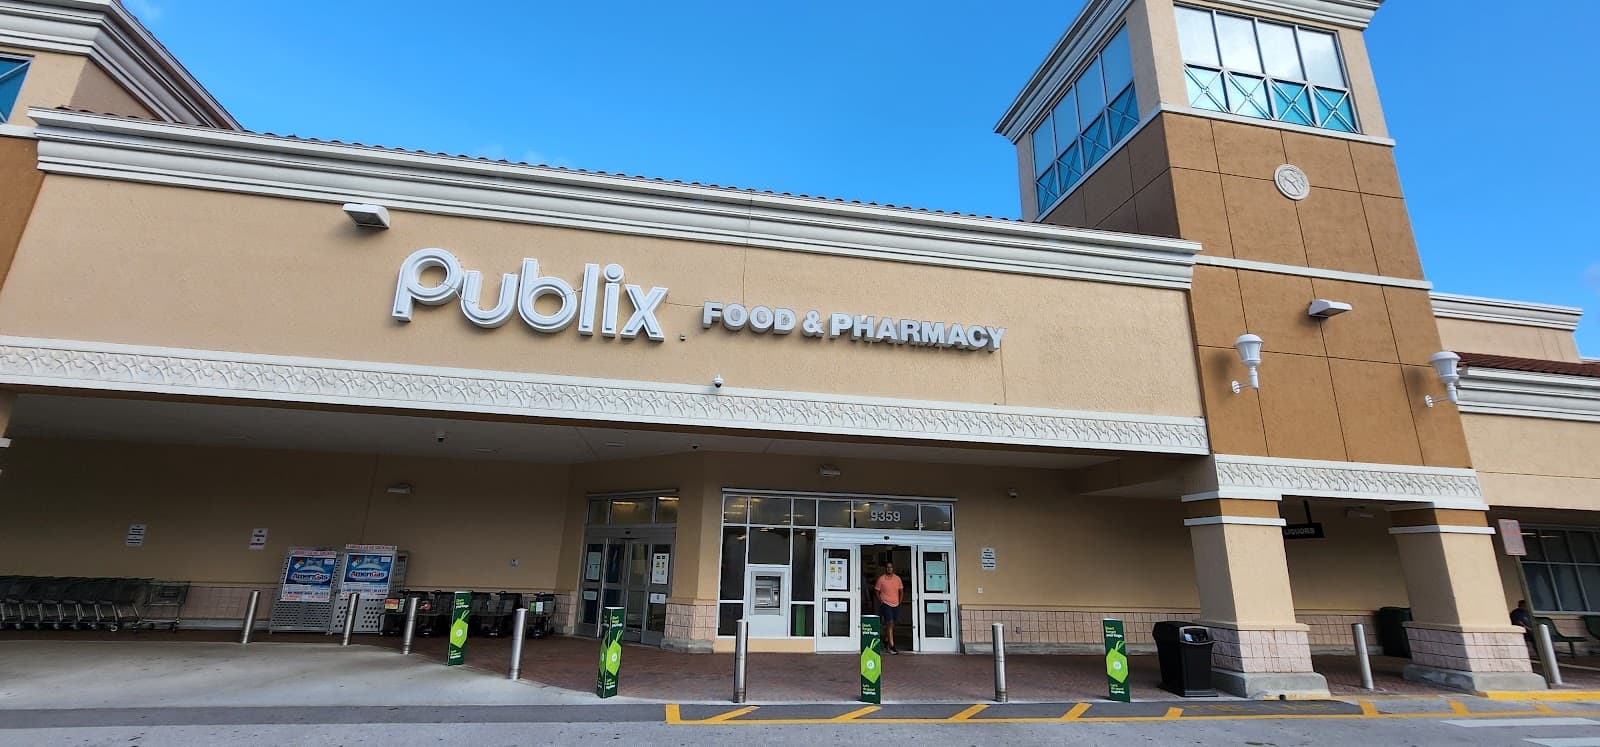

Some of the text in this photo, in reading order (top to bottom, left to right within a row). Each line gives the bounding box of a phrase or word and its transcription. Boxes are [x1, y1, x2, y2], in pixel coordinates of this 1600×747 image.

[703, 301, 1006, 352] FOOD & PHARMACY
[870, 510, 901, 522] 9359
